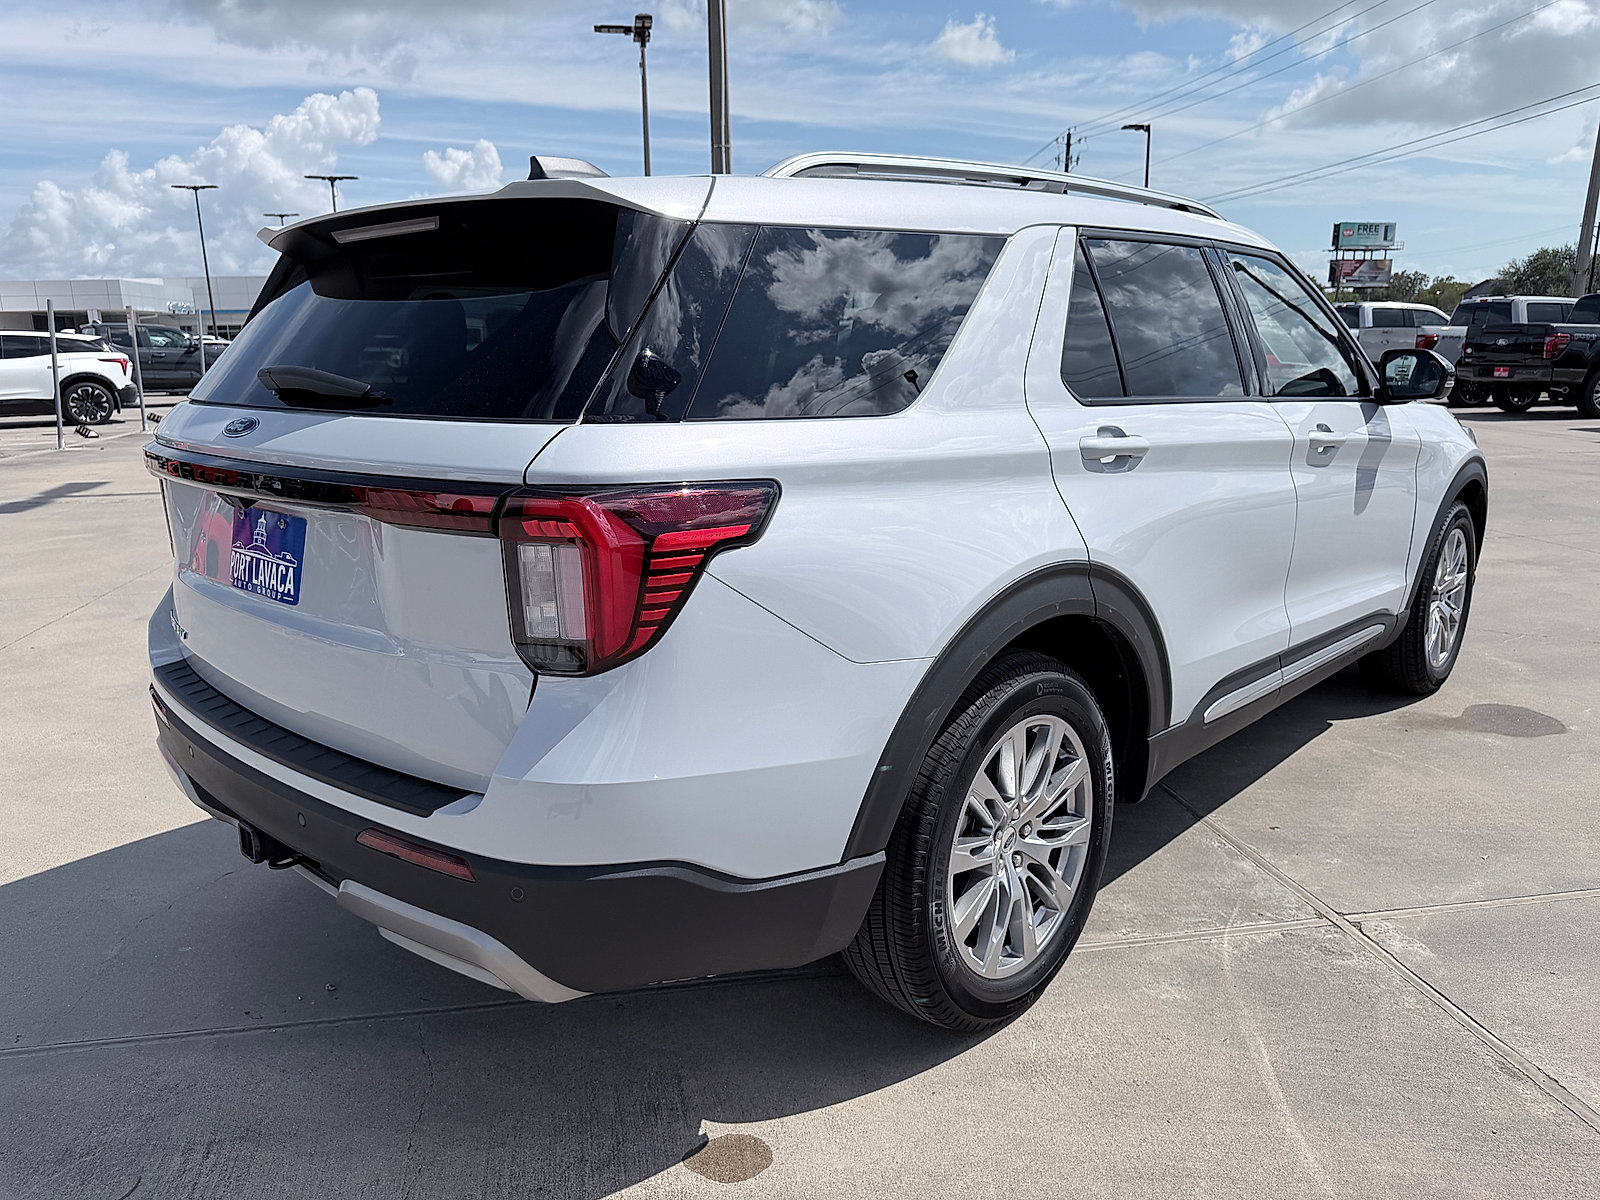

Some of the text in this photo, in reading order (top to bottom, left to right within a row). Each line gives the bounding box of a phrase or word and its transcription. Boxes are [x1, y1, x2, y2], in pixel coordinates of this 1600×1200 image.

[1357, 224, 1380, 233] FREE
[230, 550, 295, 596] PORT LAVACA
[233, 580, 282, 601] AUTO GROUP
